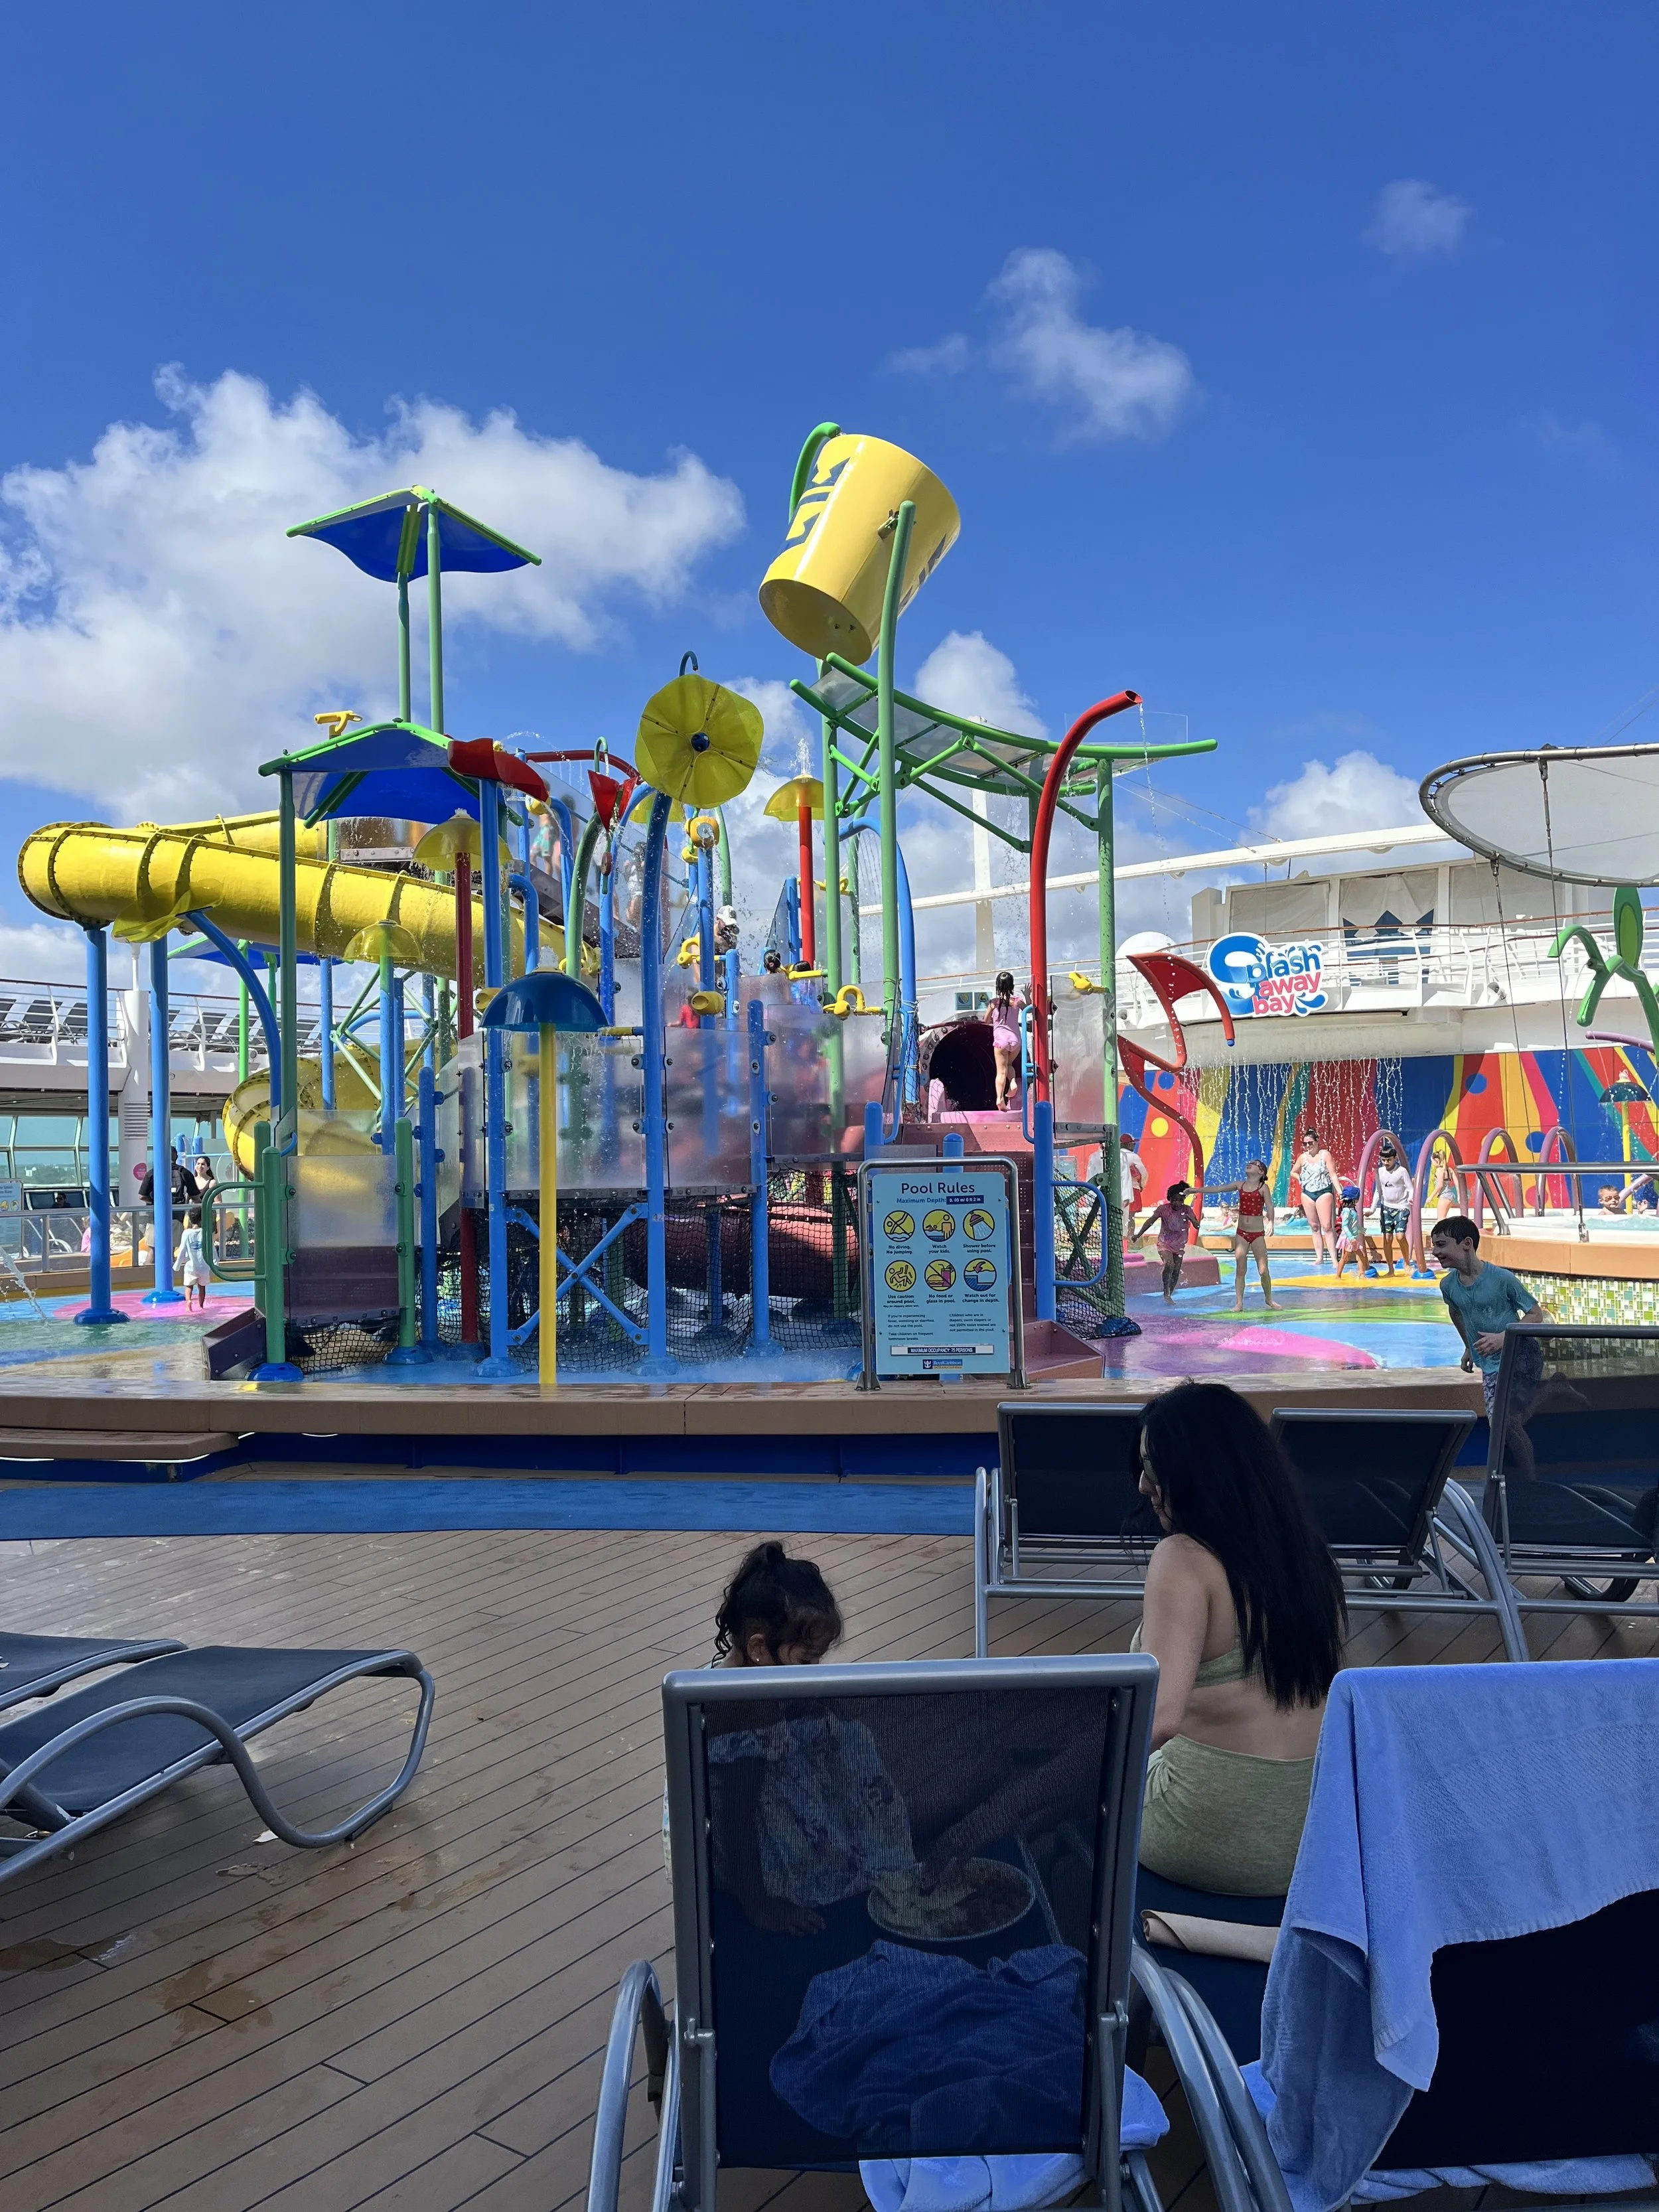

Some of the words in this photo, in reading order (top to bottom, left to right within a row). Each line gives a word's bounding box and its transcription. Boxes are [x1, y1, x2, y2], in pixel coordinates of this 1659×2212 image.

[1209, 935, 1321, 1015] Splash
[1259, 972, 1321, 997] away
[1252, 994, 1295, 1015] bay
[901, 1183, 933, 1194] Pool
[938, 1182, 975, 1193] Rules
